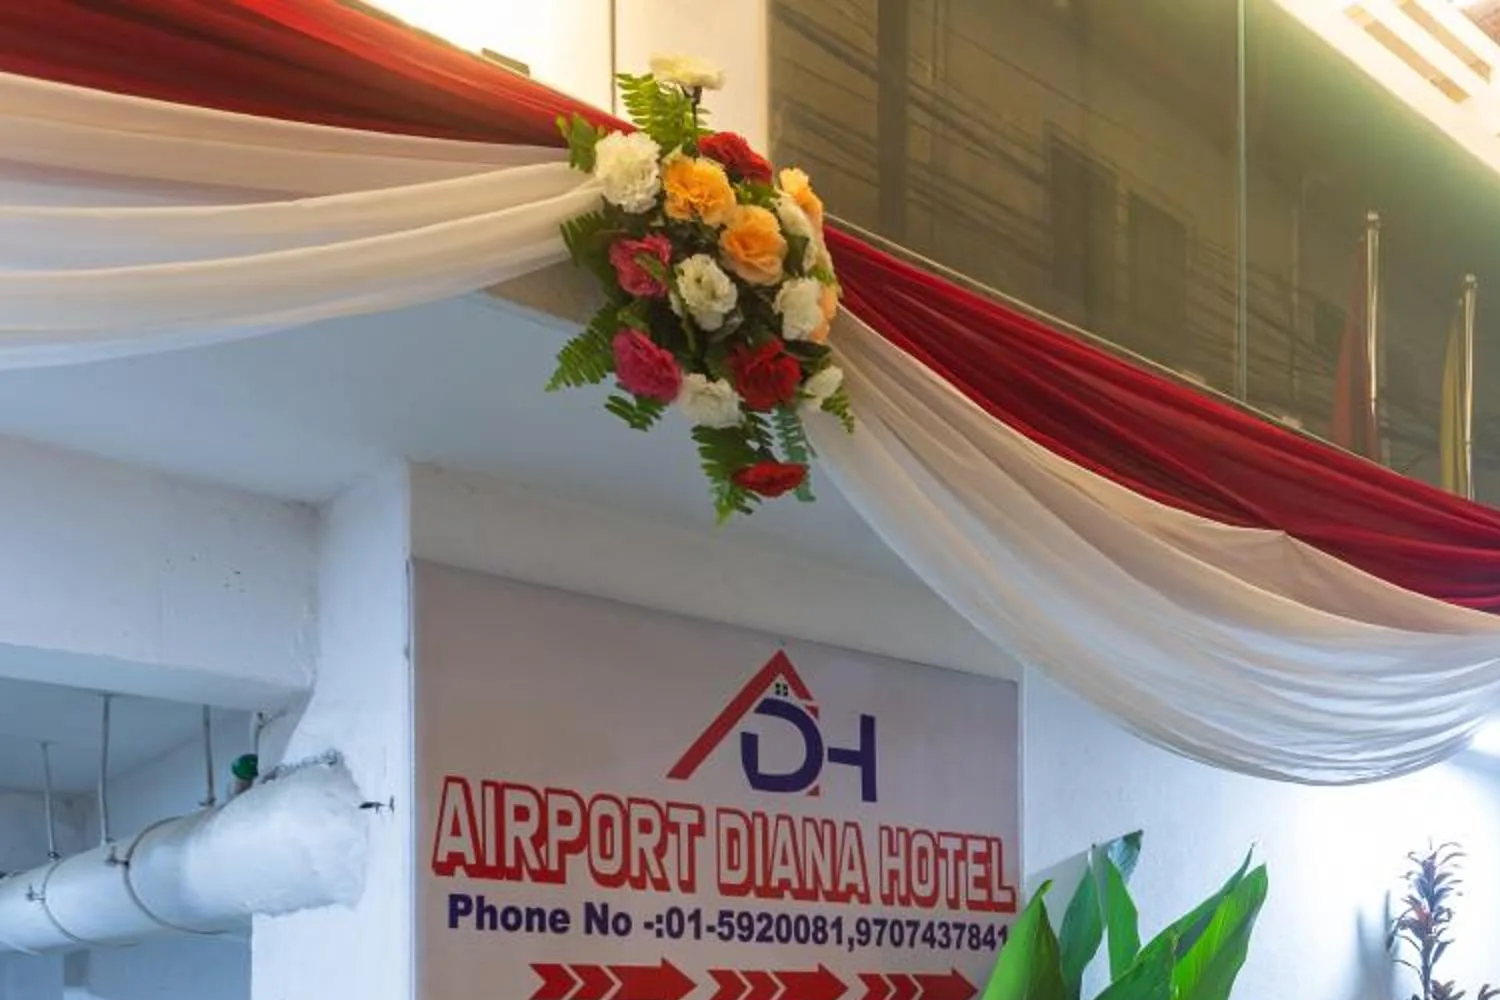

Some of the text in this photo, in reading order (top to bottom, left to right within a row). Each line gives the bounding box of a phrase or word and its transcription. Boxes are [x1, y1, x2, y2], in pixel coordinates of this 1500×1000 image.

[432, 776, 1016, 913] AIRPORT DIANA HOTEL
[448, 893, 571, 933] Phone
[583, 902, 632, 937] No
